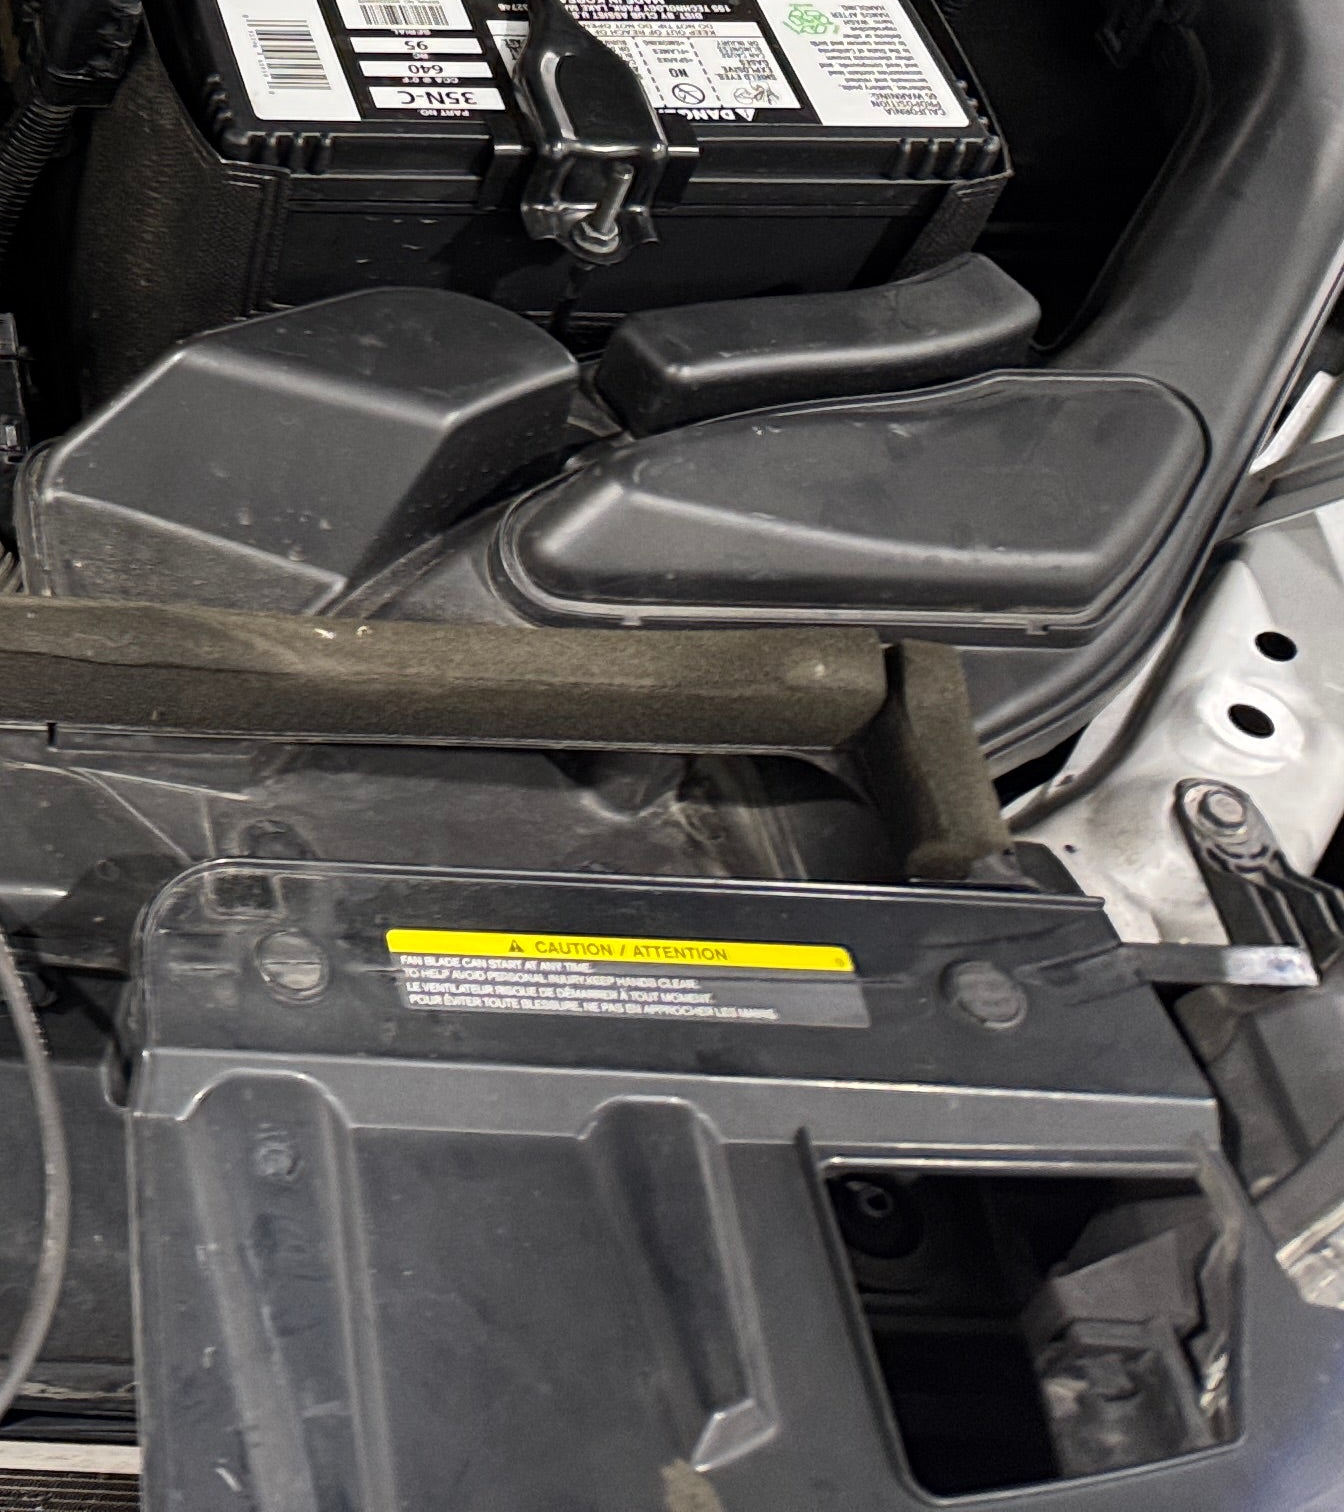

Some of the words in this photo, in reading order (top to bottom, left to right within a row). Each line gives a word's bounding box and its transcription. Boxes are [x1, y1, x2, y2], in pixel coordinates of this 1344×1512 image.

[642, 4, 706, 12] TECHNOLOGY
[630, 11, 657, 20] CLUB
[404, 40, 429, 51] 95
[407, 63, 444, 74] 640
[668, 68, 689, 79] NO
[397, 90, 478, 106] 35N-C
[870, 99, 942, 109] PROPOSITION
[416, 108, 438, 117] NO.
[440, 108, 470, 118] PART
[884, 107, 947, 117] CALIFORNIA
[535, 940, 614, 957] CAUTION
[619, 944, 626, 956] /
[633, 945, 728, 961] ATTENTION
[399, 955, 423, 966] FAN
[424, 956, 461, 967] BLADE
[462, 957, 487, 969] CAN
[488, 958, 523, 970] START
[524, 959, 538, 970] AT
[404, 968, 420, 978] TO
[421, 969, 450, 979] HELP
[451, 970, 486, 980] AVOID
[406, 982, 422, 992] LE
[423, 982, 494, 995] VENTILATEUR
[409, 994, 443, 1005] POUR
[484, 998, 520, 1008] TOUTE
